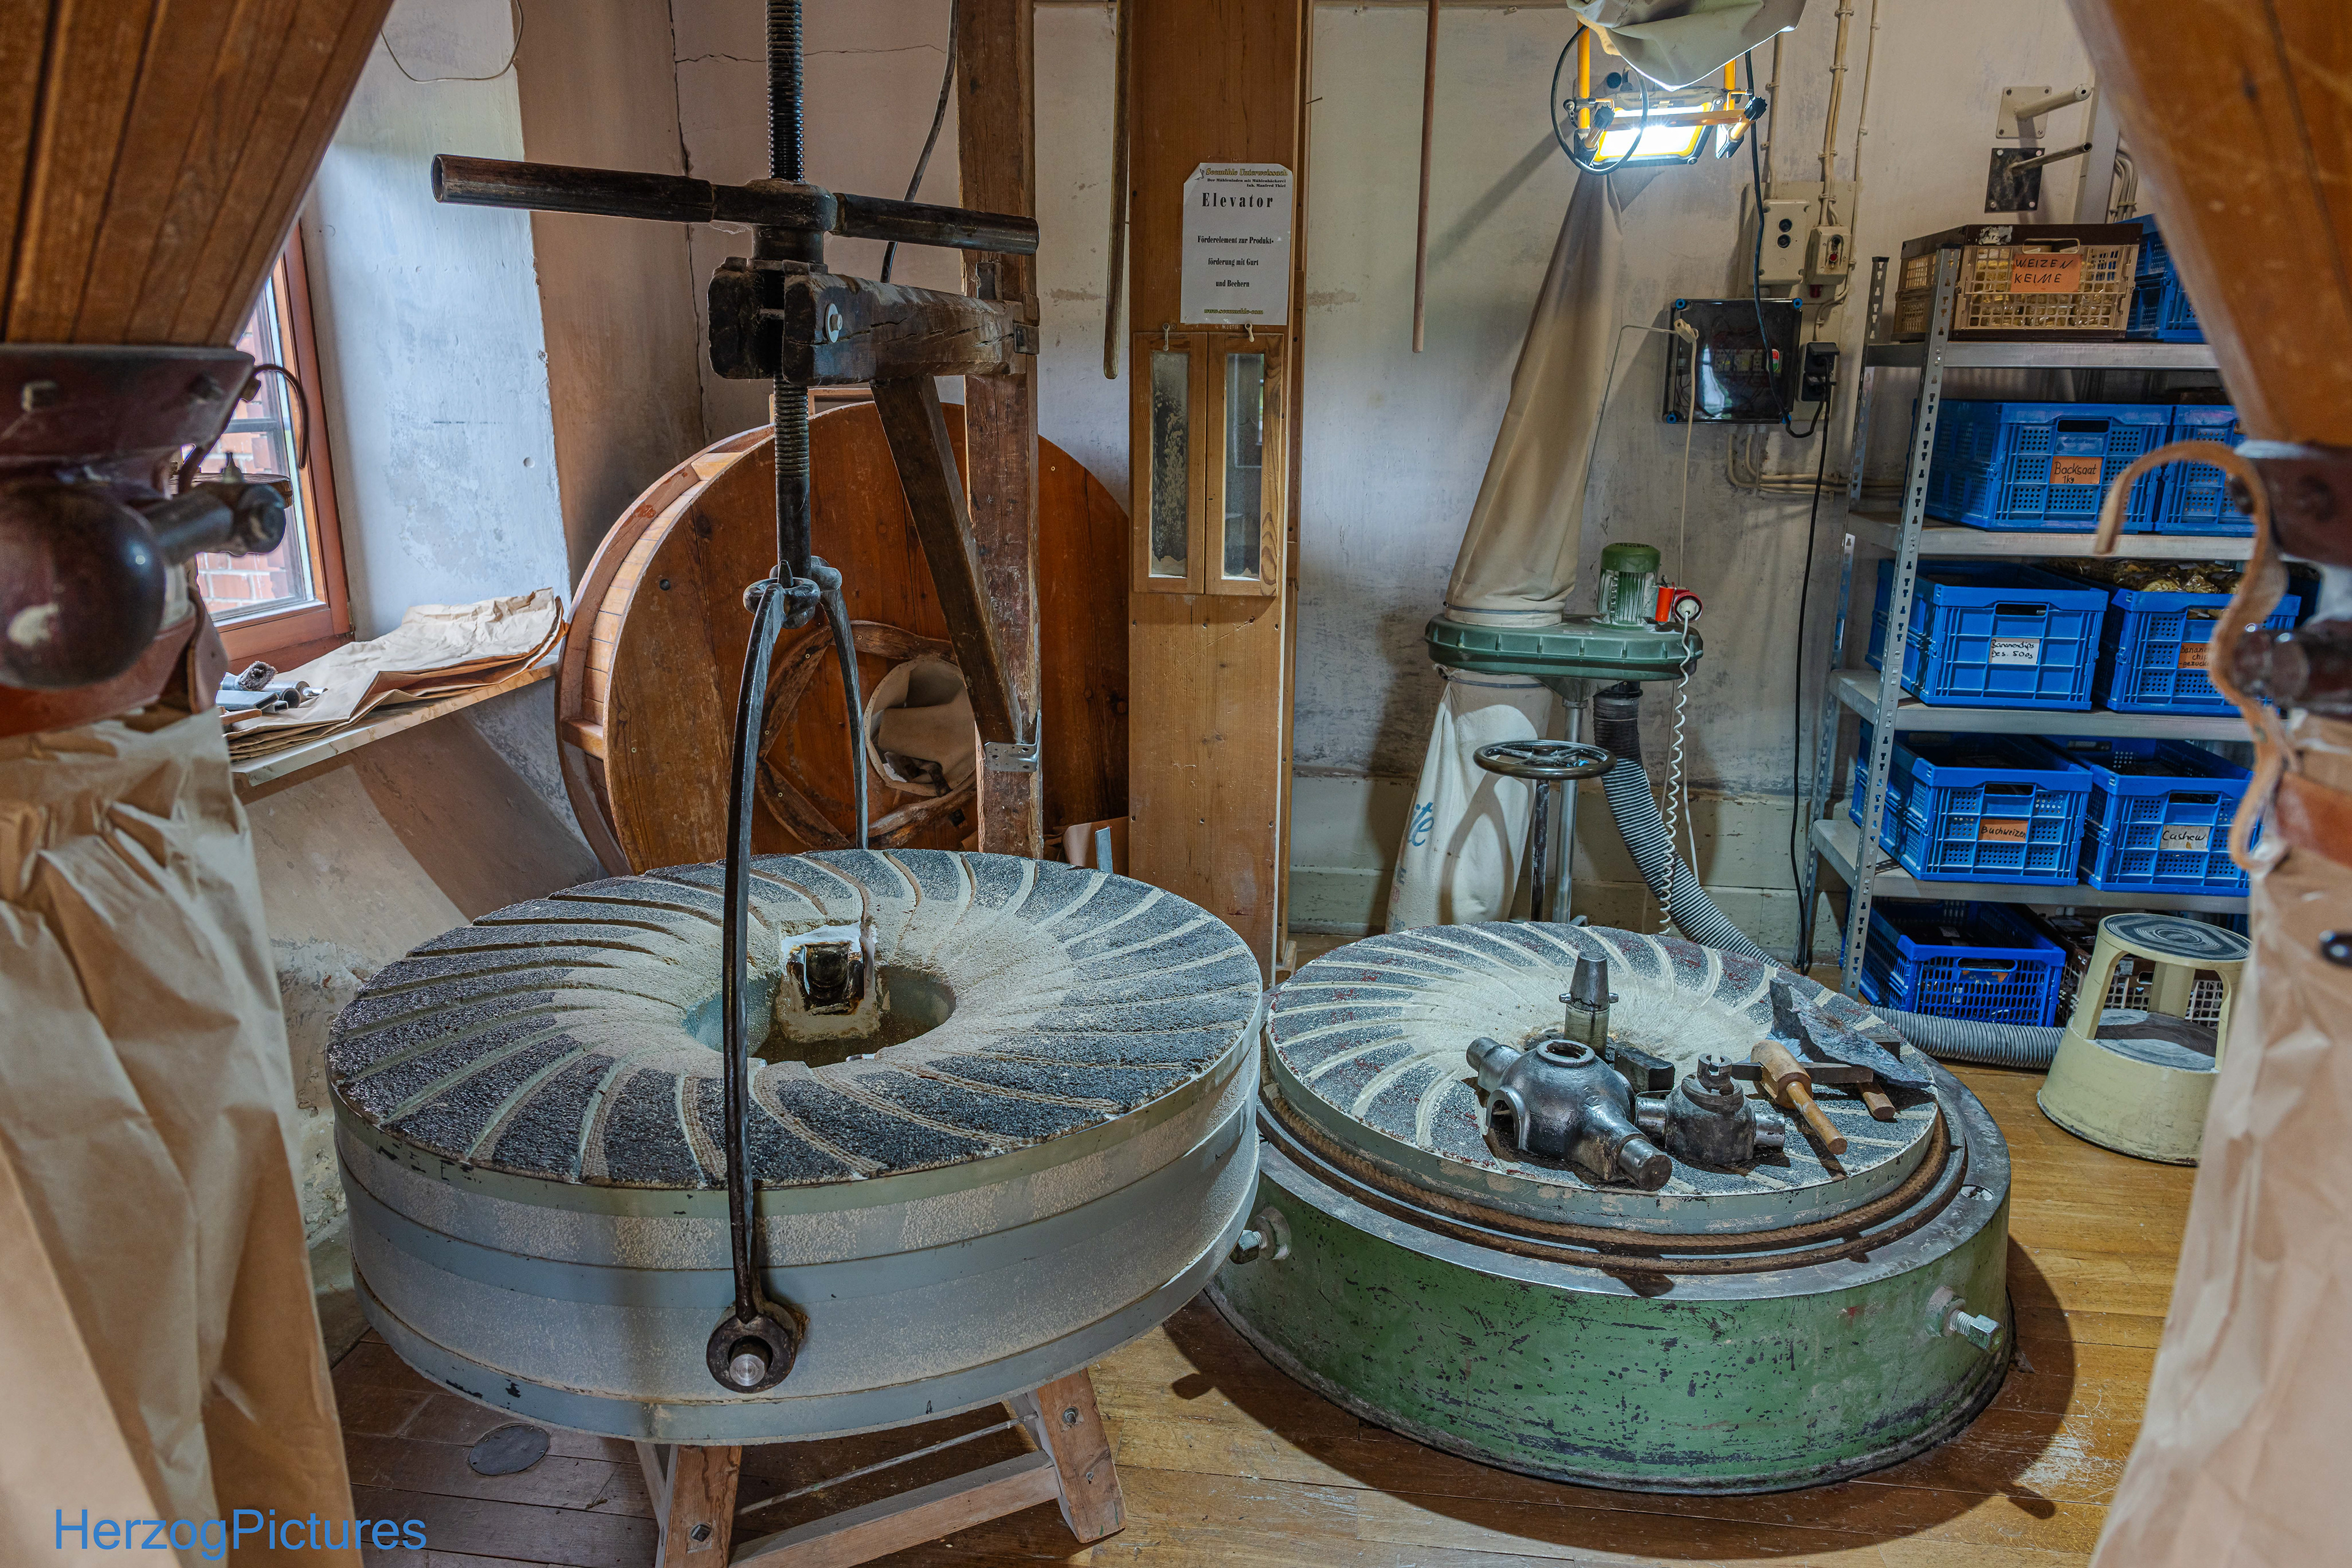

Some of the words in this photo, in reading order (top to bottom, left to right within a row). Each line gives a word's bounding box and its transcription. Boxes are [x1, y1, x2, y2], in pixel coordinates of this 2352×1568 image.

[1202, 192, 1273, 208] Elevator
[1208, 258, 1235, 267] förderung
[2016, 258, 2074, 269] WEIZEN
[2014, 273, 2062, 284] KEIME
[2054, 461, 2097, 475] Backsaat
[1980, 826, 2027, 839] Buchweizen
[2162, 830, 2206, 841] Cashew
